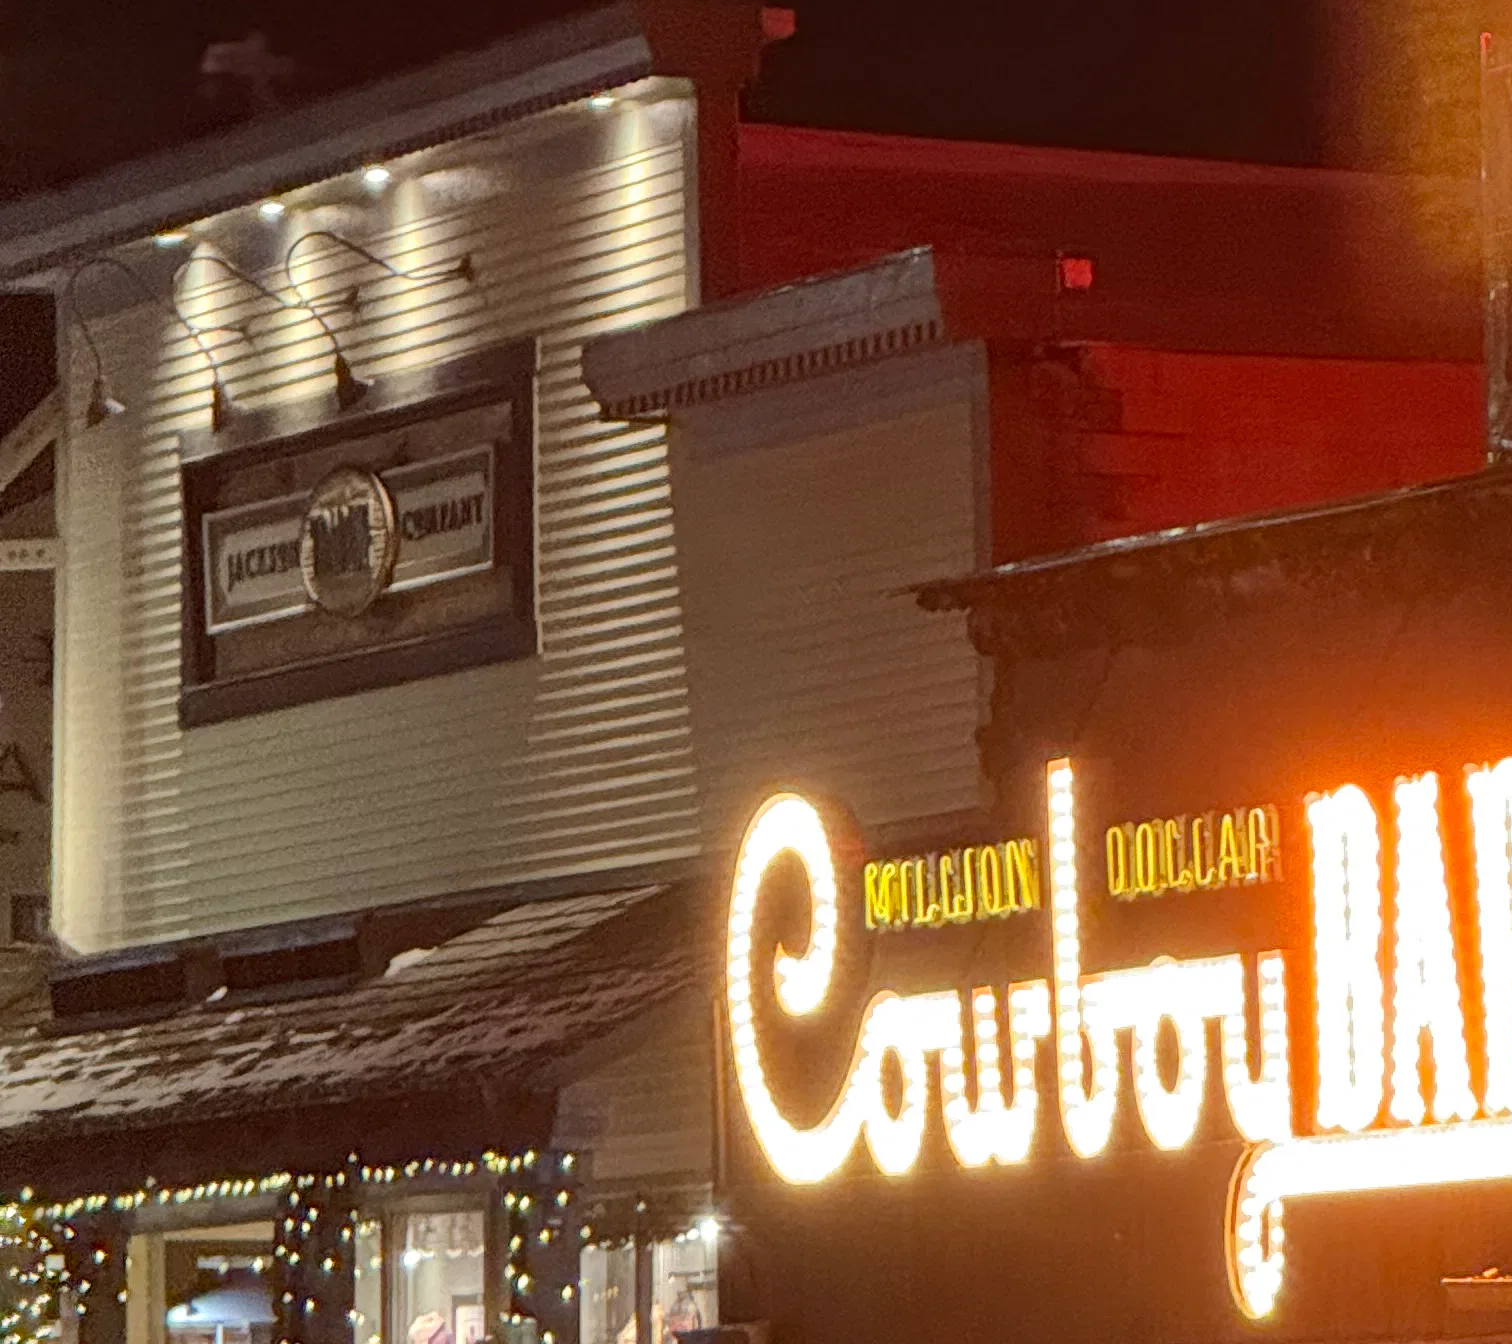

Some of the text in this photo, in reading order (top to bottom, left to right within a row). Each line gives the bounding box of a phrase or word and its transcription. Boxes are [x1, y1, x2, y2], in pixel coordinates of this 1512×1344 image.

[725, 756, 1296, 1320] Cowboy
[864, 806, 1284, 932] MILLION DOLLAR
